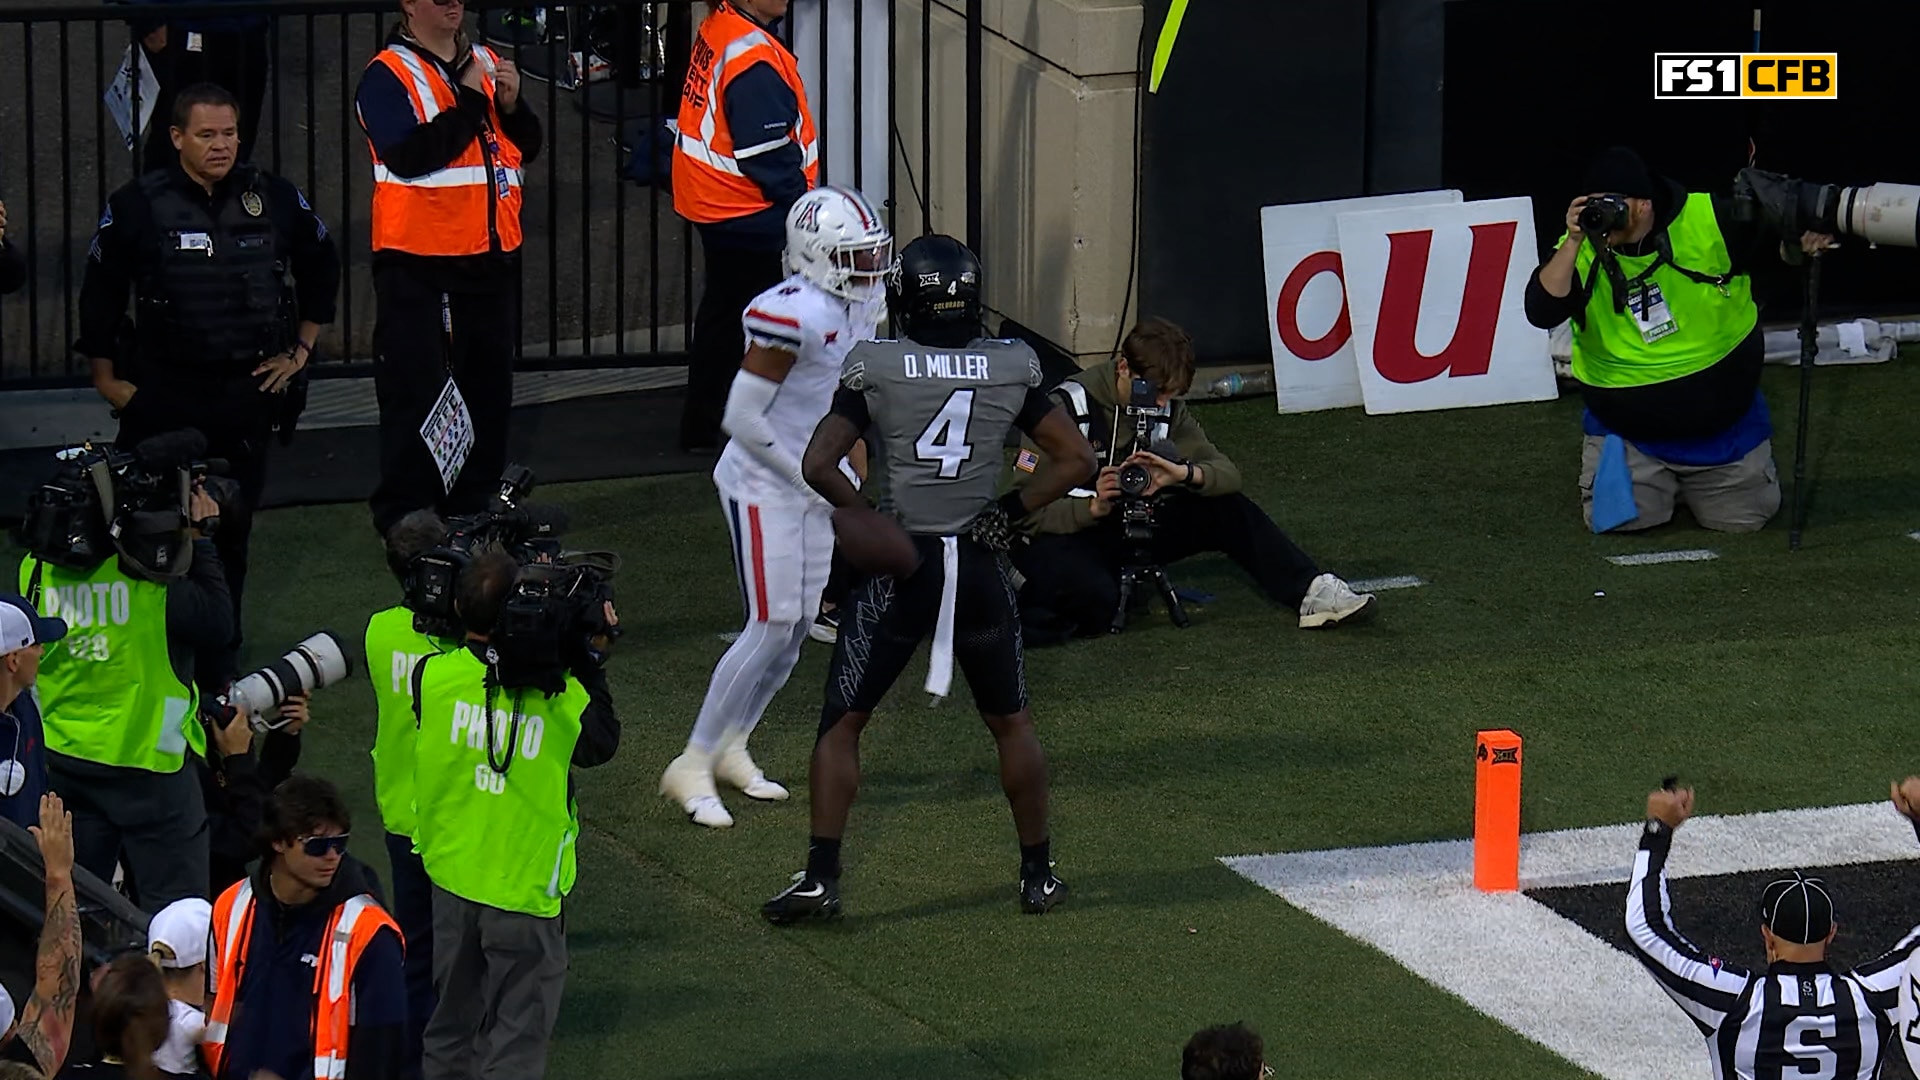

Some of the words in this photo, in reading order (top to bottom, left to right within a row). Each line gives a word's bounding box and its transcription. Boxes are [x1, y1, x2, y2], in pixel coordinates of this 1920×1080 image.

[933, 300, 966, 311] COLORADO
[947, 280, 957, 296] 4
[925, 353, 990, 381] MILLER
[913, 387, 977, 480] 4
[45, 580, 130, 629] PHOTO
[450, 700, 545, 761] PHOTO
[1783, 1013, 1838, 1080] S
